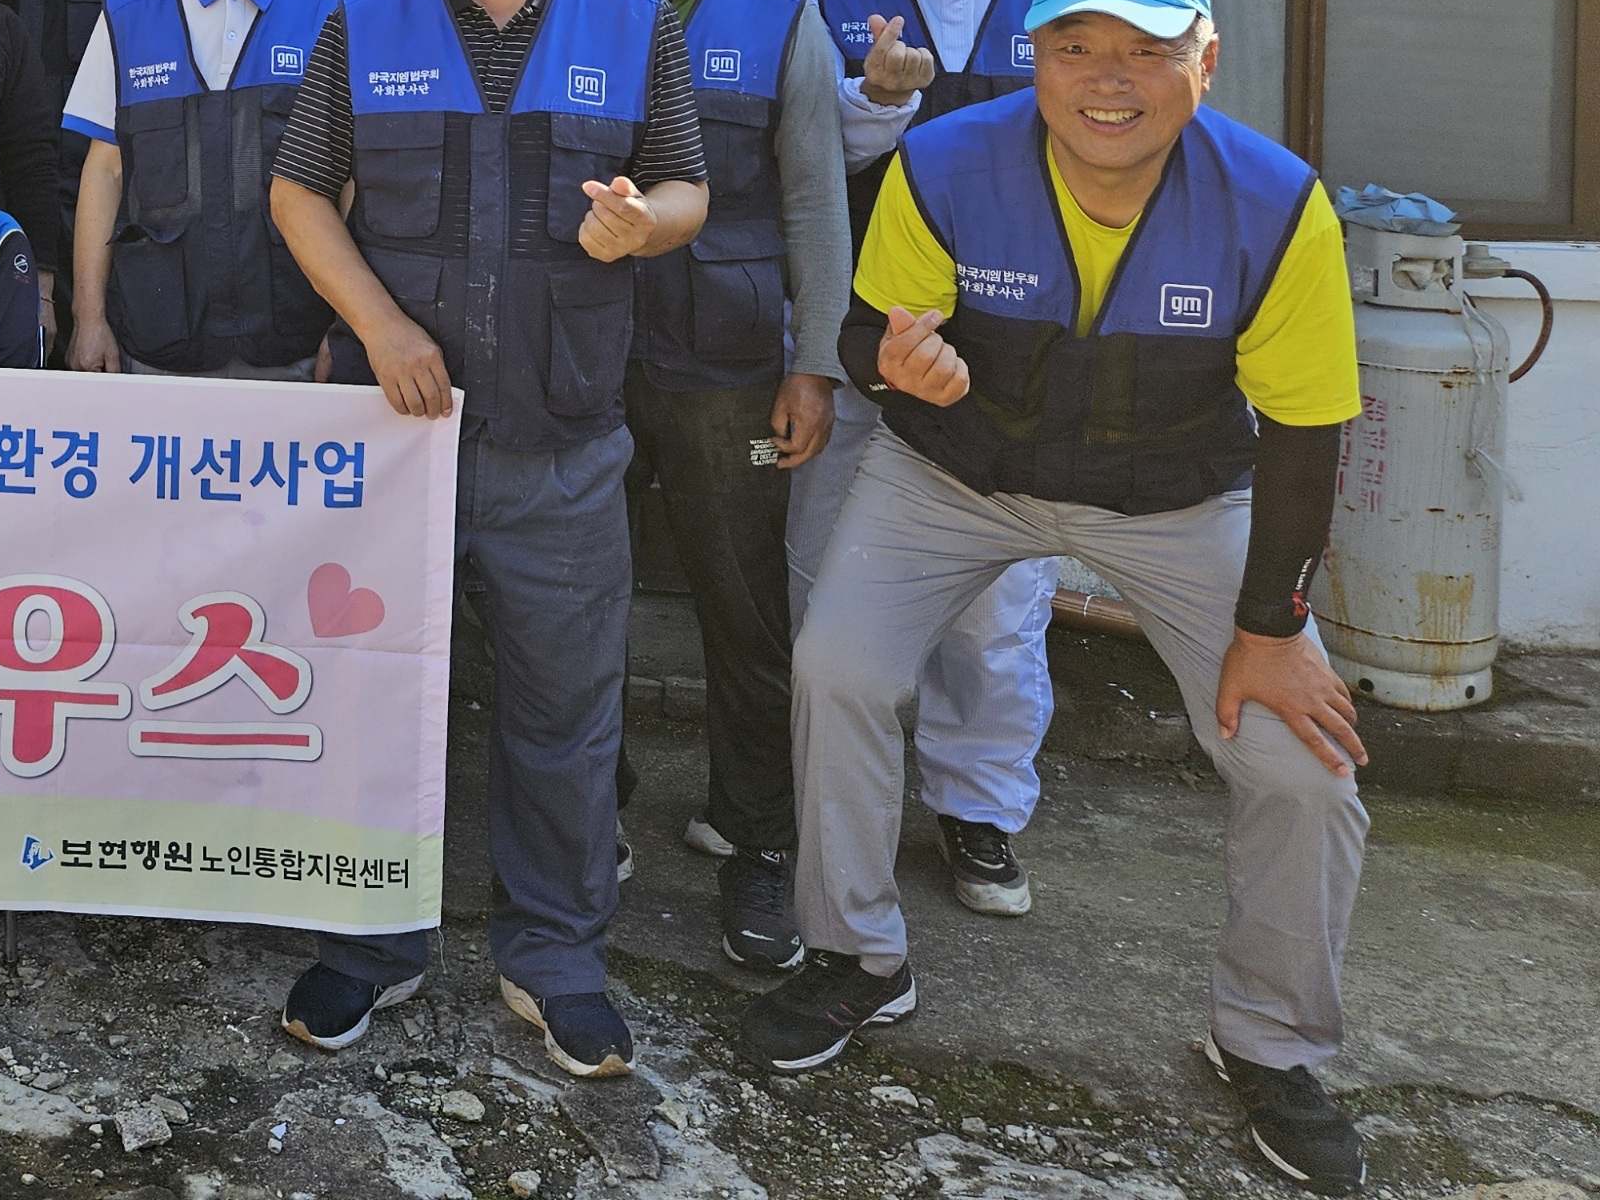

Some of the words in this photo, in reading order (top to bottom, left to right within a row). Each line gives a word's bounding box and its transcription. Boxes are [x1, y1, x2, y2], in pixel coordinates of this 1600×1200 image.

[841, 21, 871, 32] 한국지
[277, 52, 299, 69] gm
[711, 57, 734, 72] gm
[129, 64, 155, 79] 한국지엠
[155, 61, 177, 74] 법우회
[368, 71, 409, 84] 한국지엠
[410, 68, 440, 81] 법우회
[133, 73, 170, 90] 사회봉사단
[372, 81, 430, 97] 사회봉사단
[575, 75, 599, 97] gm
[956, 263, 1002, 283] 한국지엠
[1003, 270, 1039, 287] 법우회
[958, 279, 1026, 301] 사회봉사단
[1171, 296, 1202, 317] gm
[129, 434, 365, 509] 개선사업
[60, 839, 193, 873] 보현행원
[200, 845, 410, 890] 노인통합지원센터
